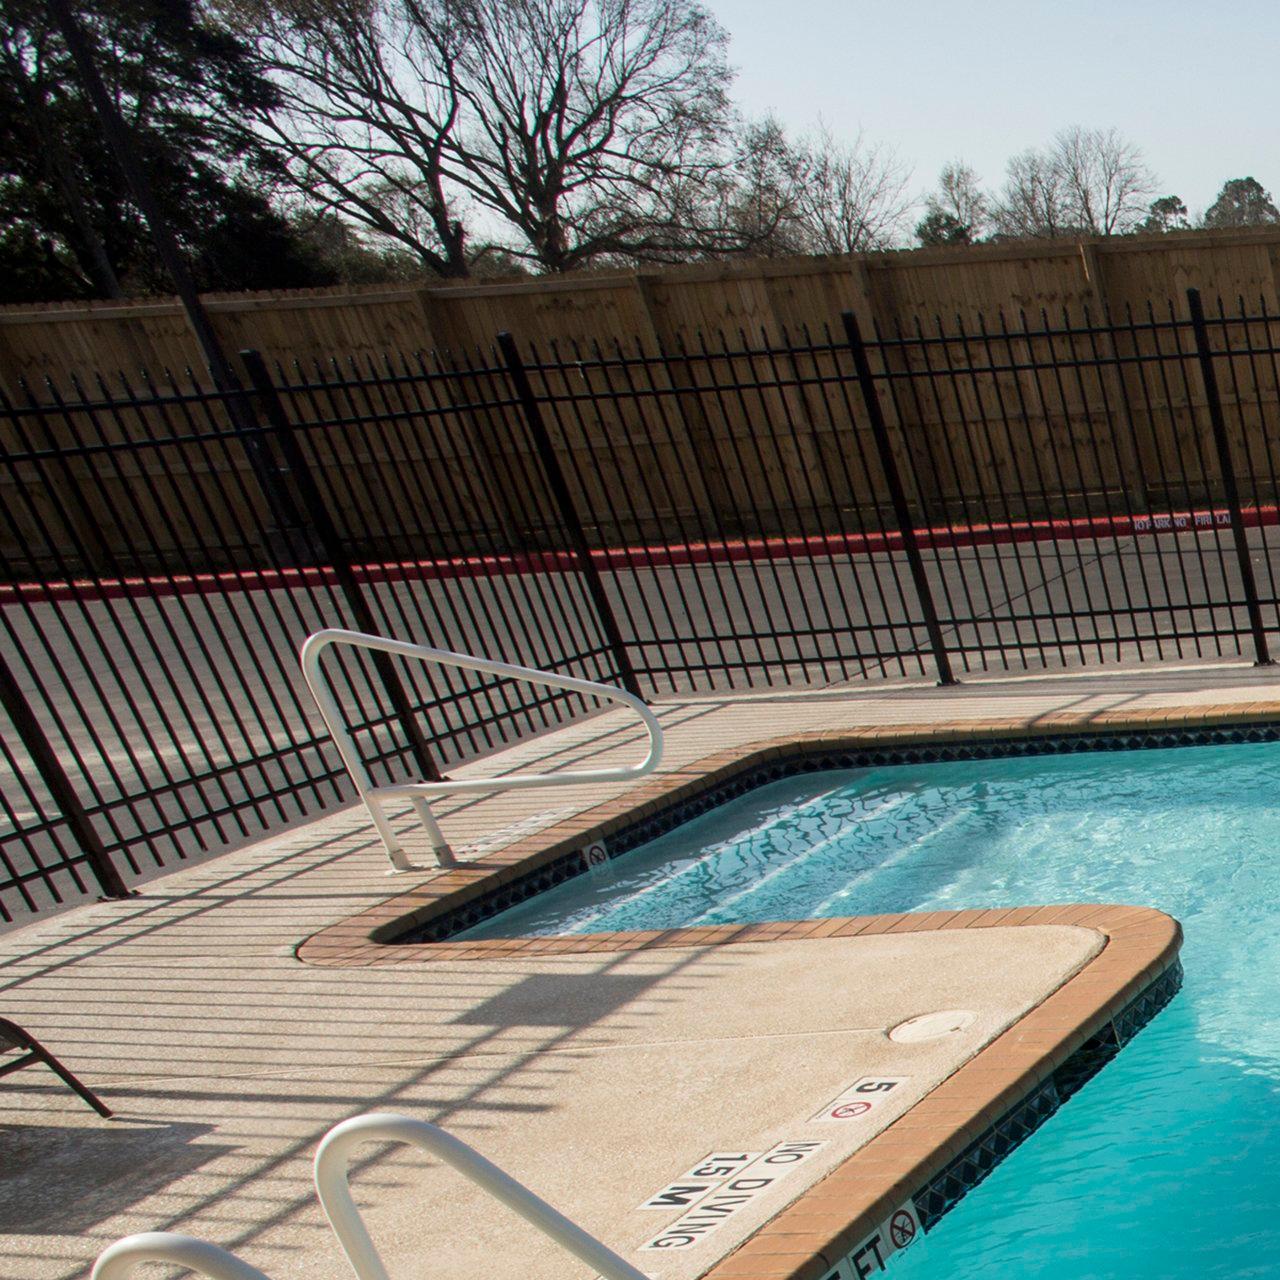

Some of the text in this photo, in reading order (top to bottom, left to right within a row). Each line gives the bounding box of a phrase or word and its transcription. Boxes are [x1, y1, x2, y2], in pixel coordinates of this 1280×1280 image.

[855, 1082, 898, 1093] 5
[648, 1153, 748, 1206] 1.5 M
[649, 1142, 821, 1248] NO DIVING
